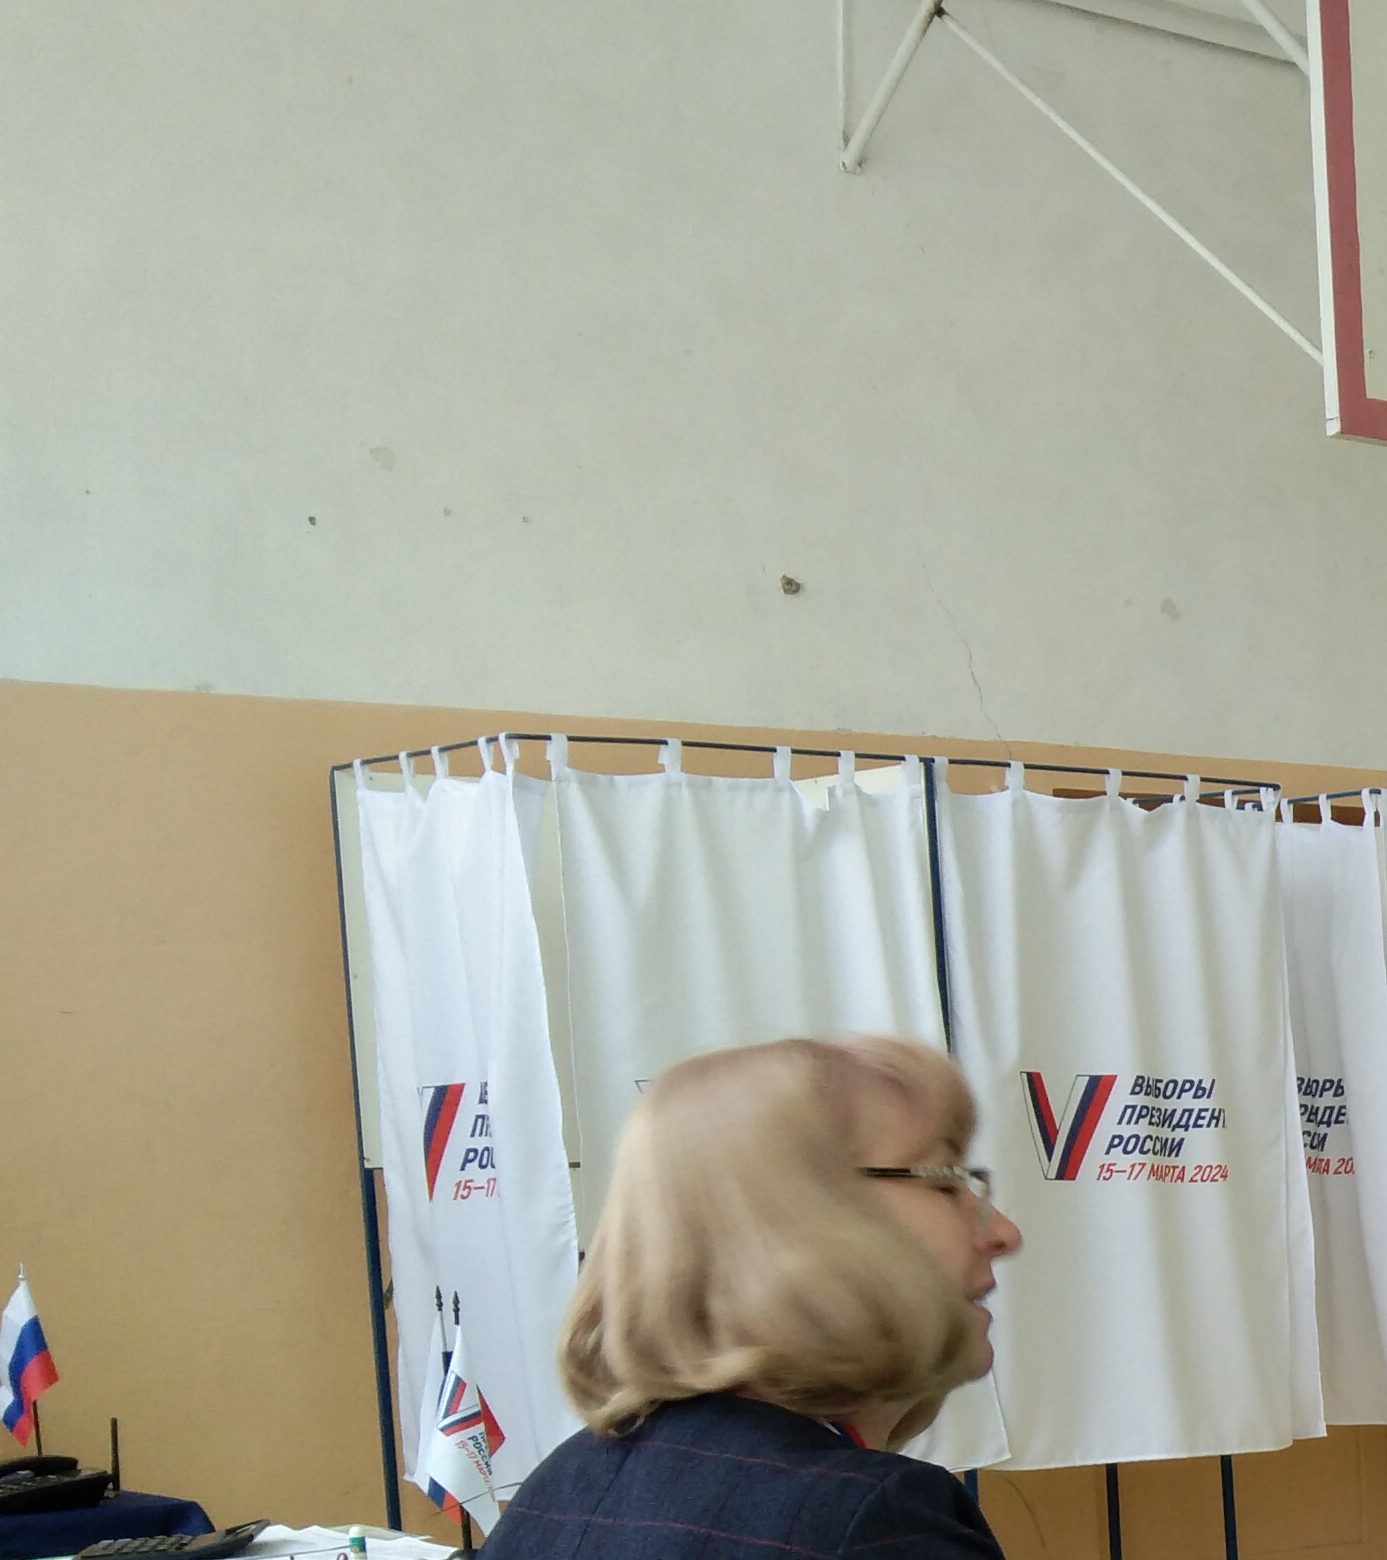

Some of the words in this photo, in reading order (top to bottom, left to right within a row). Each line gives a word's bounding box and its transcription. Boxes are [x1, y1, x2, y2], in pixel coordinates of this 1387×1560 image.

[1129, 1075, 1216, 1100] ВЫБОРЫ
[1117, 1104, 1227, 1132] ПРЕЗИДЕН
[1104, 1133, 1186, 1158] РОССИИ
[1147, 1162, 1187, 1183] МАРТА
[1188, 1164, 1229, 1183] 2024
